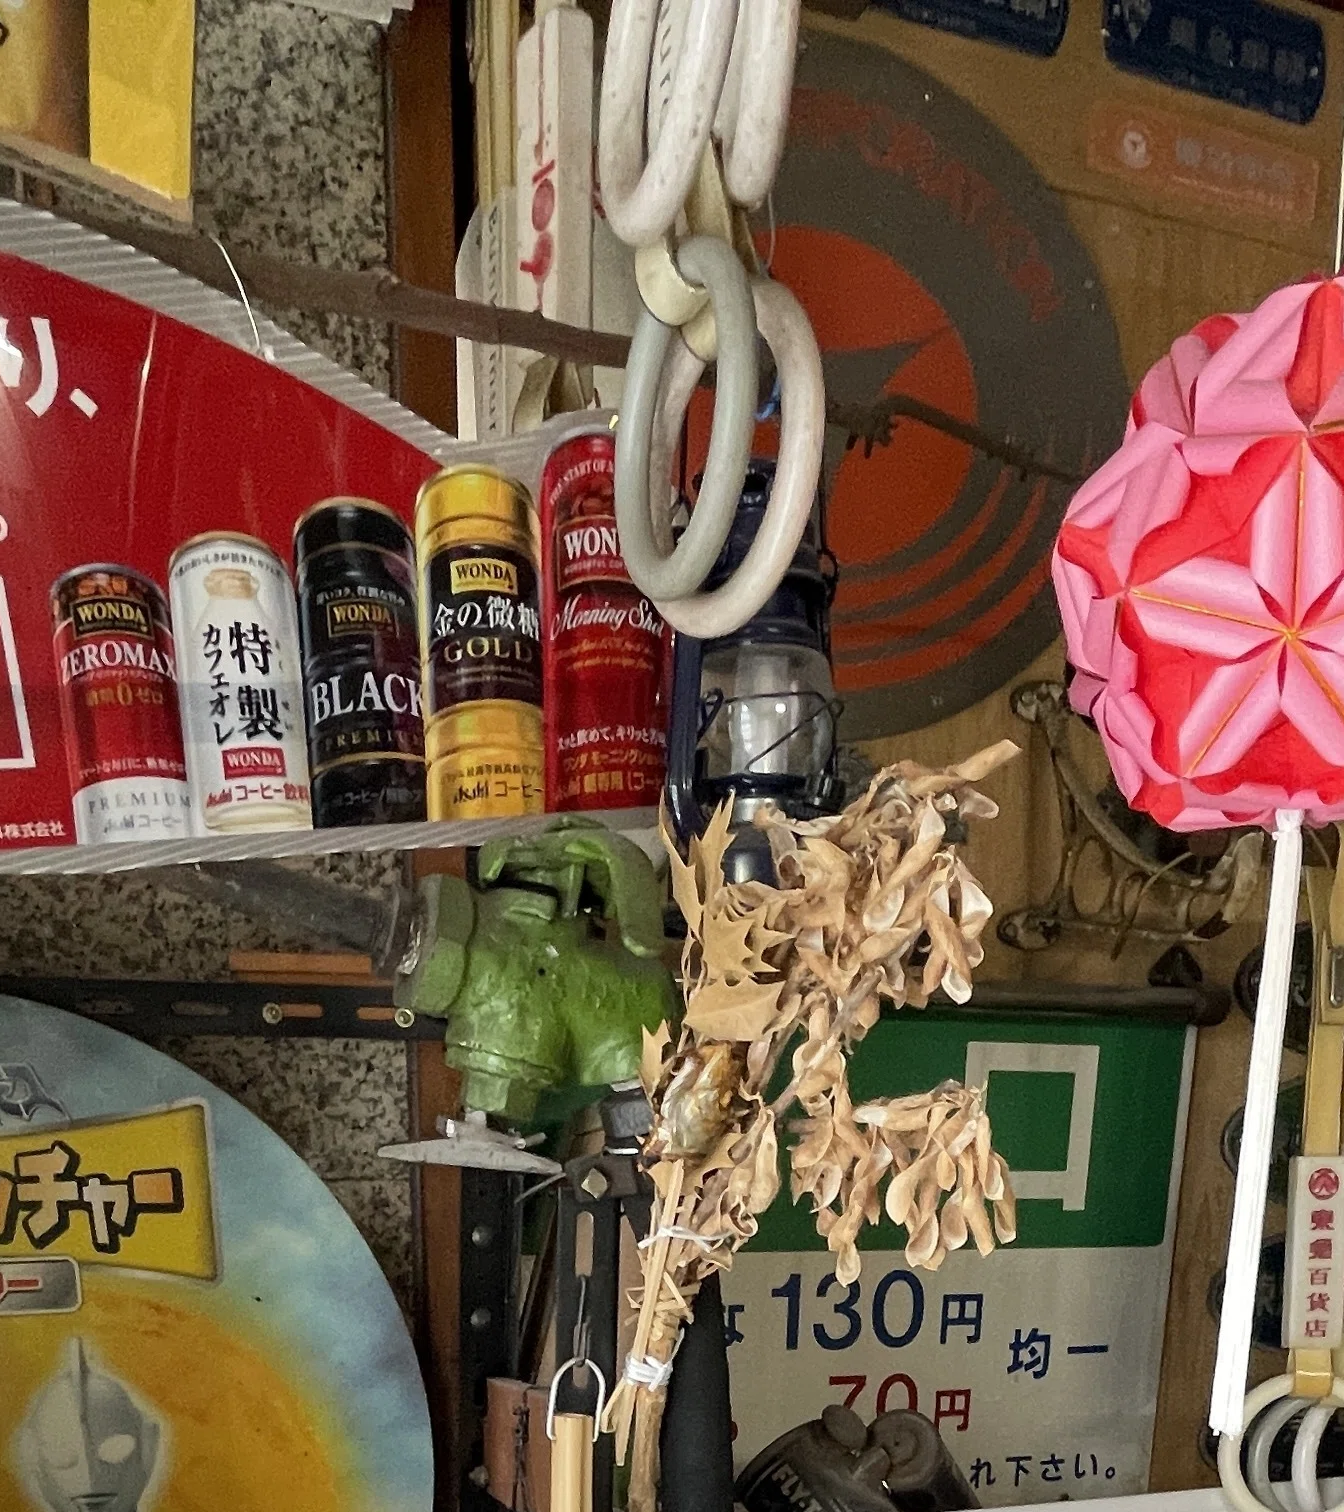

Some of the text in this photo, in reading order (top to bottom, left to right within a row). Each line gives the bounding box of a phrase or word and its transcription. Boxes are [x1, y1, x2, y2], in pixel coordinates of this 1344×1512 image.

[564, 527, 622, 561] WON
[455, 562, 514, 585] WONDA
[76, 602, 146, 624] WONDA
[332, 604, 393, 625] WONDA
[551, 593, 624, 641] Morning
[59, 640, 178, 685] ZEROMAX
[444, 636, 534, 665] GOLD
[203, 623, 236, 746] カフェオレ
[229, 621, 284, 742] 特製
[311, 671, 424, 726] BLACK
[226, 749, 281, 769] WONDA
[494, 780, 544, 800] コーヒー
[1305, 1209, 1335, 1338] 東急百貨店
[771, 1269, 985, 1351] 130円
[1007, 1328, 1110, 1380] 均一
[828, 1373, 972, 1433] 70円
